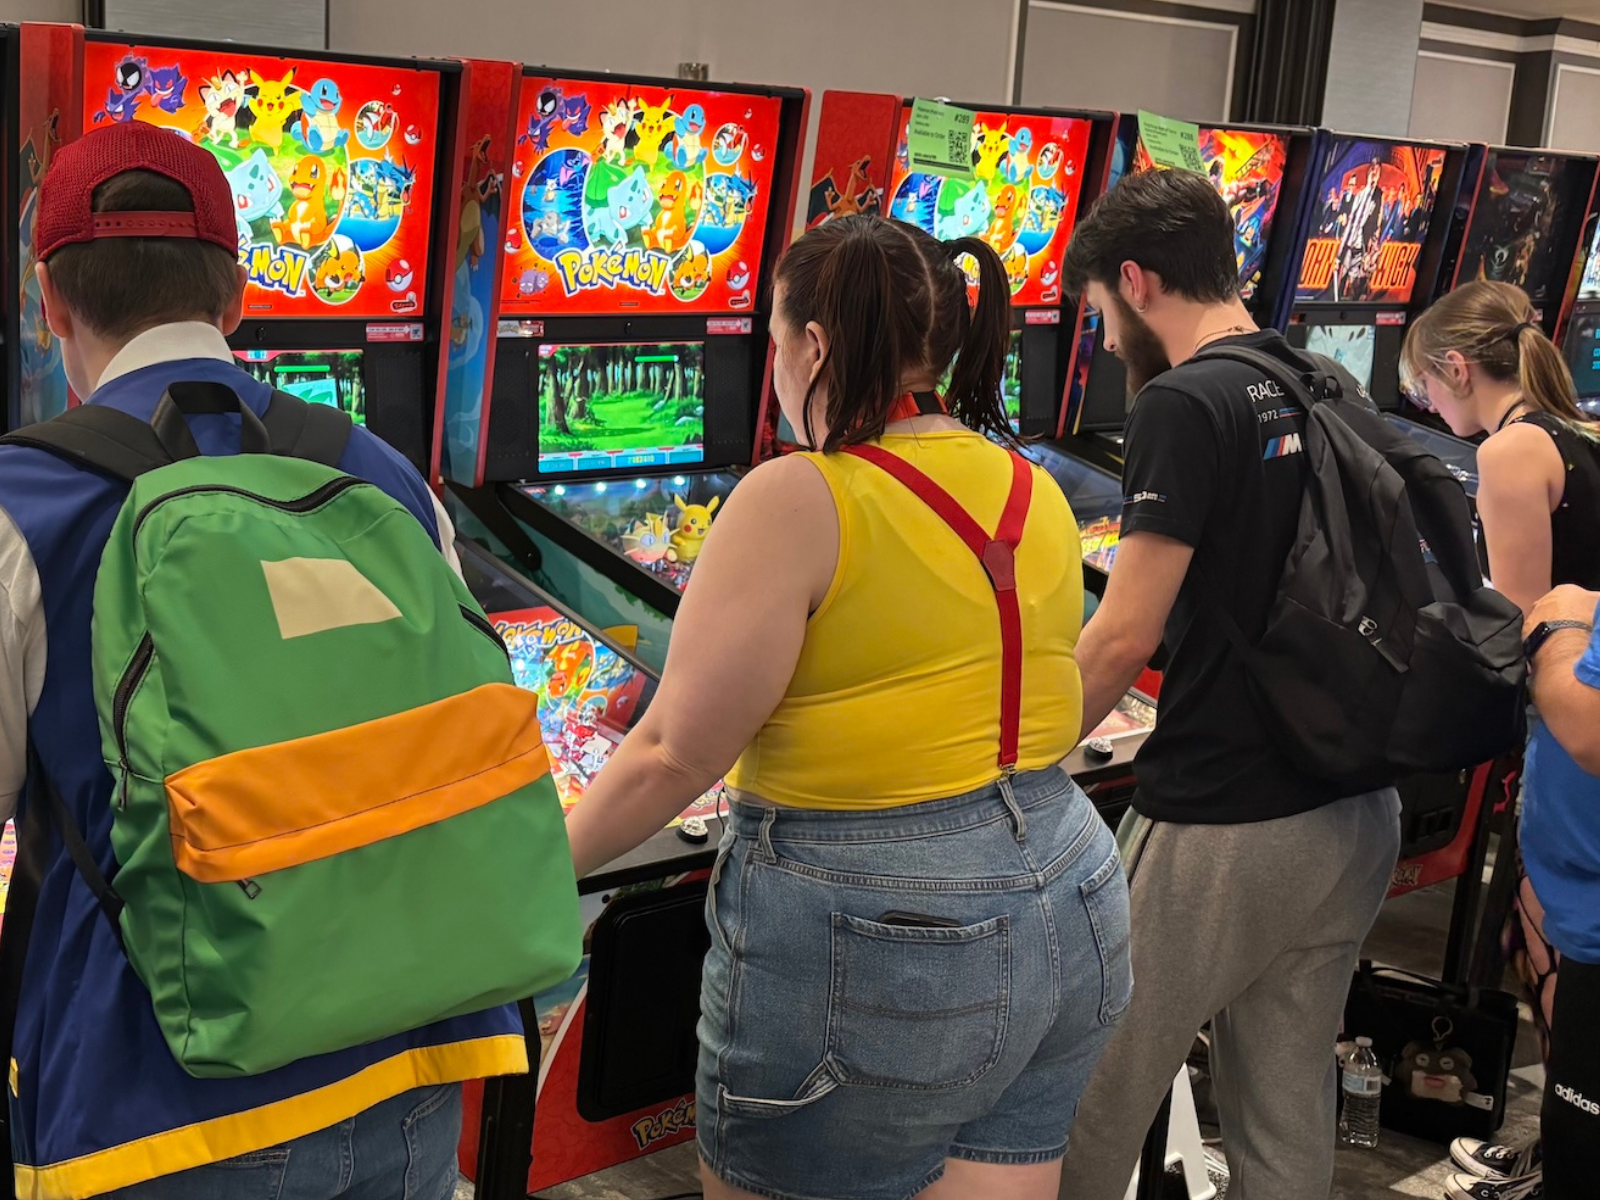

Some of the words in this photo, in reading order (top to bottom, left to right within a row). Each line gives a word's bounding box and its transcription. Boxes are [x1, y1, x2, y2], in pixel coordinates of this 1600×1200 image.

[555, 243, 670, 296] Pokémon
[1258, 409, 1279, 424] 1972
[1554, 1083, 1600, 1115] adidas
[631, 1098, 696, 1149] Pokém
